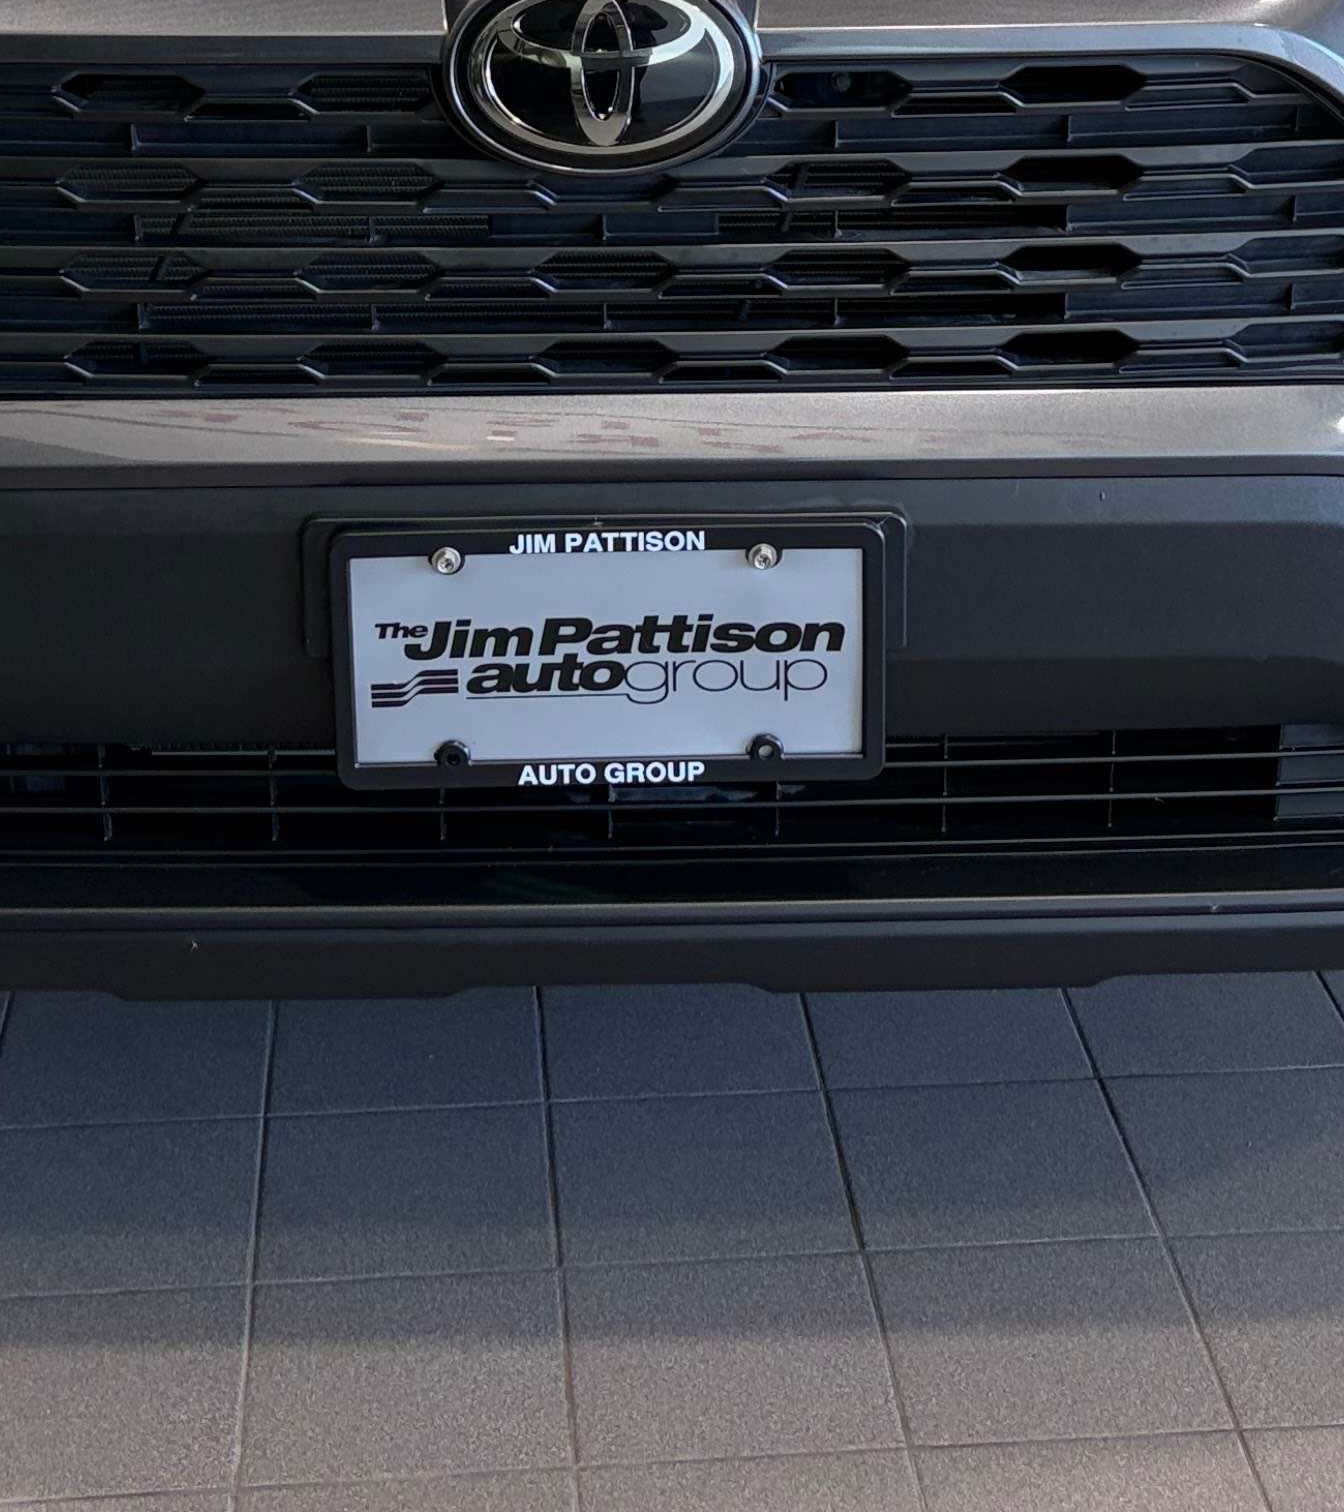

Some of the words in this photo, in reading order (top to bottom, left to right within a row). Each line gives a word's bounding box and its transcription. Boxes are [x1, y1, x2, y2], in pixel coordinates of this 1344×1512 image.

[509, 534, 558, 555] JIM
[564, 530, 706, 554] PATTISON
[374, 621, 428, 640] The
[404, 619, 534, 660] Jim
[539, 614, 845, 656] Pattison
[518, 763, 597, 786] AUTO
[604, 761, 706, 784] GROUP
